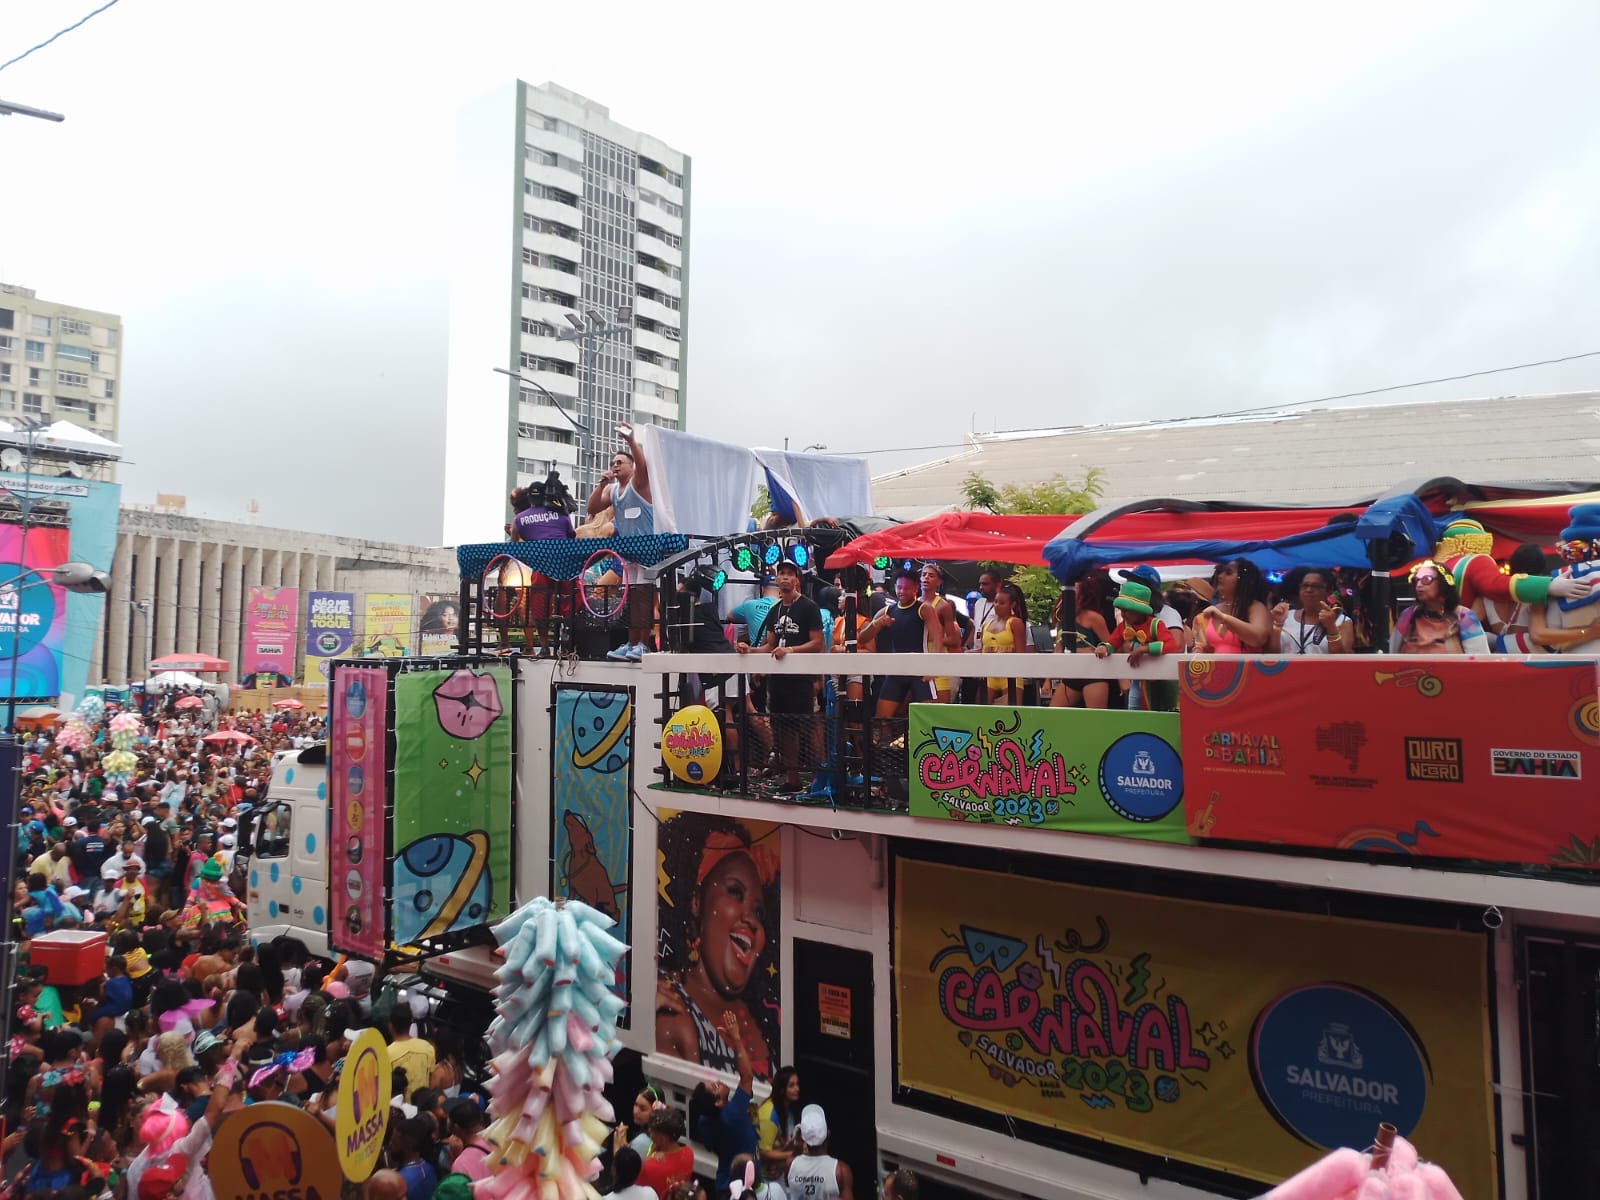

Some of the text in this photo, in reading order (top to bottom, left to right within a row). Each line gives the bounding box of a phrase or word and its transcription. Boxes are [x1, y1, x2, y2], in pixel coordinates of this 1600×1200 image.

[520, 510, 559, 526] PRODUÇÃO
[314, 598, 335, 607] NÃO
[311, 620, 350, 628] TOQUE
[1203, 731, 1280, 749] CARNAVAL
[1408, 740, 1457, 761] OURO
[1493, 750, 1532, 759] GOVERNO
[1547, 752, 1578, 760] ESTADO
[918, 738, 1077, 798] CARNAVAL
[1411, 762, 1459, 780] NEGRO
[1494, 757, 1579, 777] BAHIA
[1117, 775, 1173, 790] SALVADOR
[942, 792, 1045, 824] SALVADOR 2023
[938, 958, 1210, 1071] CARNAVAL
[975, 1035, 1153, 1113] SALVADOR 2023
[1286, 1064, 1399, 1105] SALVADOR
[1301, 1088, 1383, 1115] PREFEITURA
[346, 1109, 384, 1158] MASSA
[805, 1184, 816, 1196] 23
